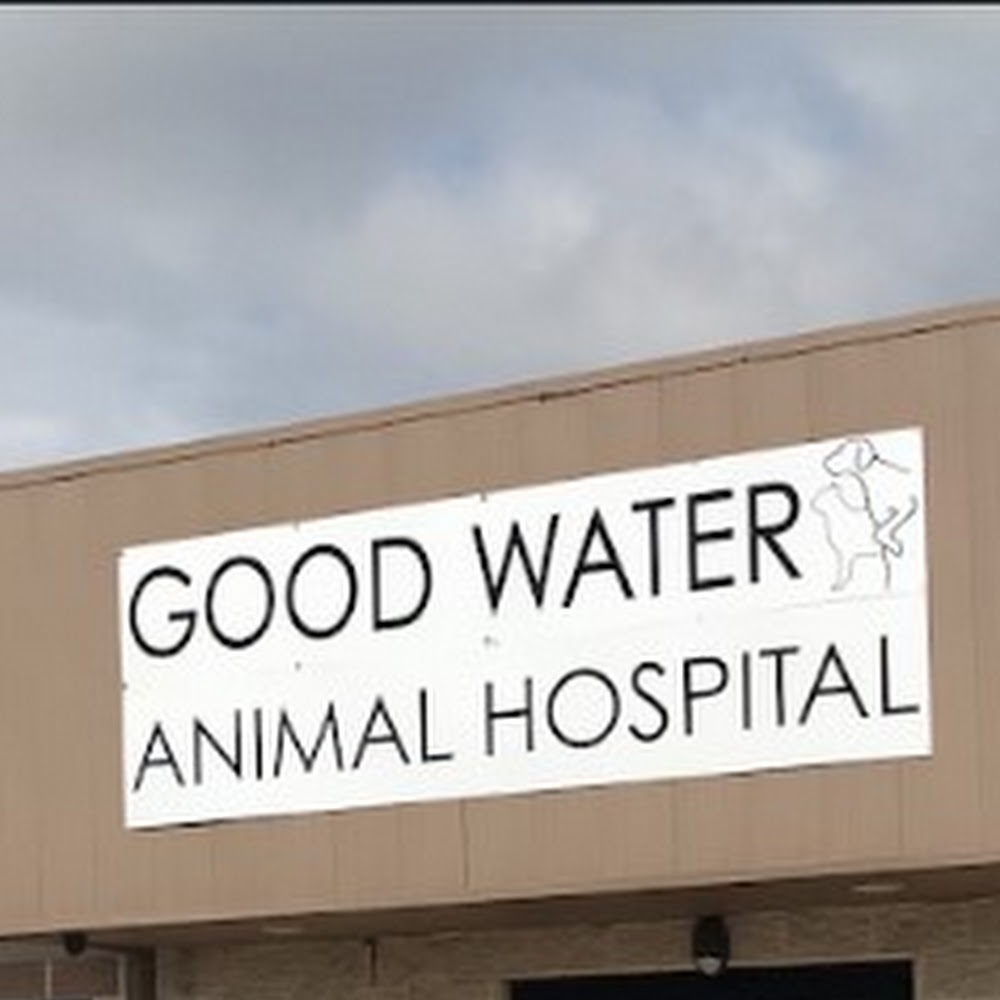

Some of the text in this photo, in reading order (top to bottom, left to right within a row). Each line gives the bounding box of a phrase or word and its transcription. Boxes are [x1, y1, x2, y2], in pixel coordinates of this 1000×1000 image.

[129, 482, 801, 658] GOOD WATER
[133, 636, 920, 791] ANIMAL HOSPITAL
